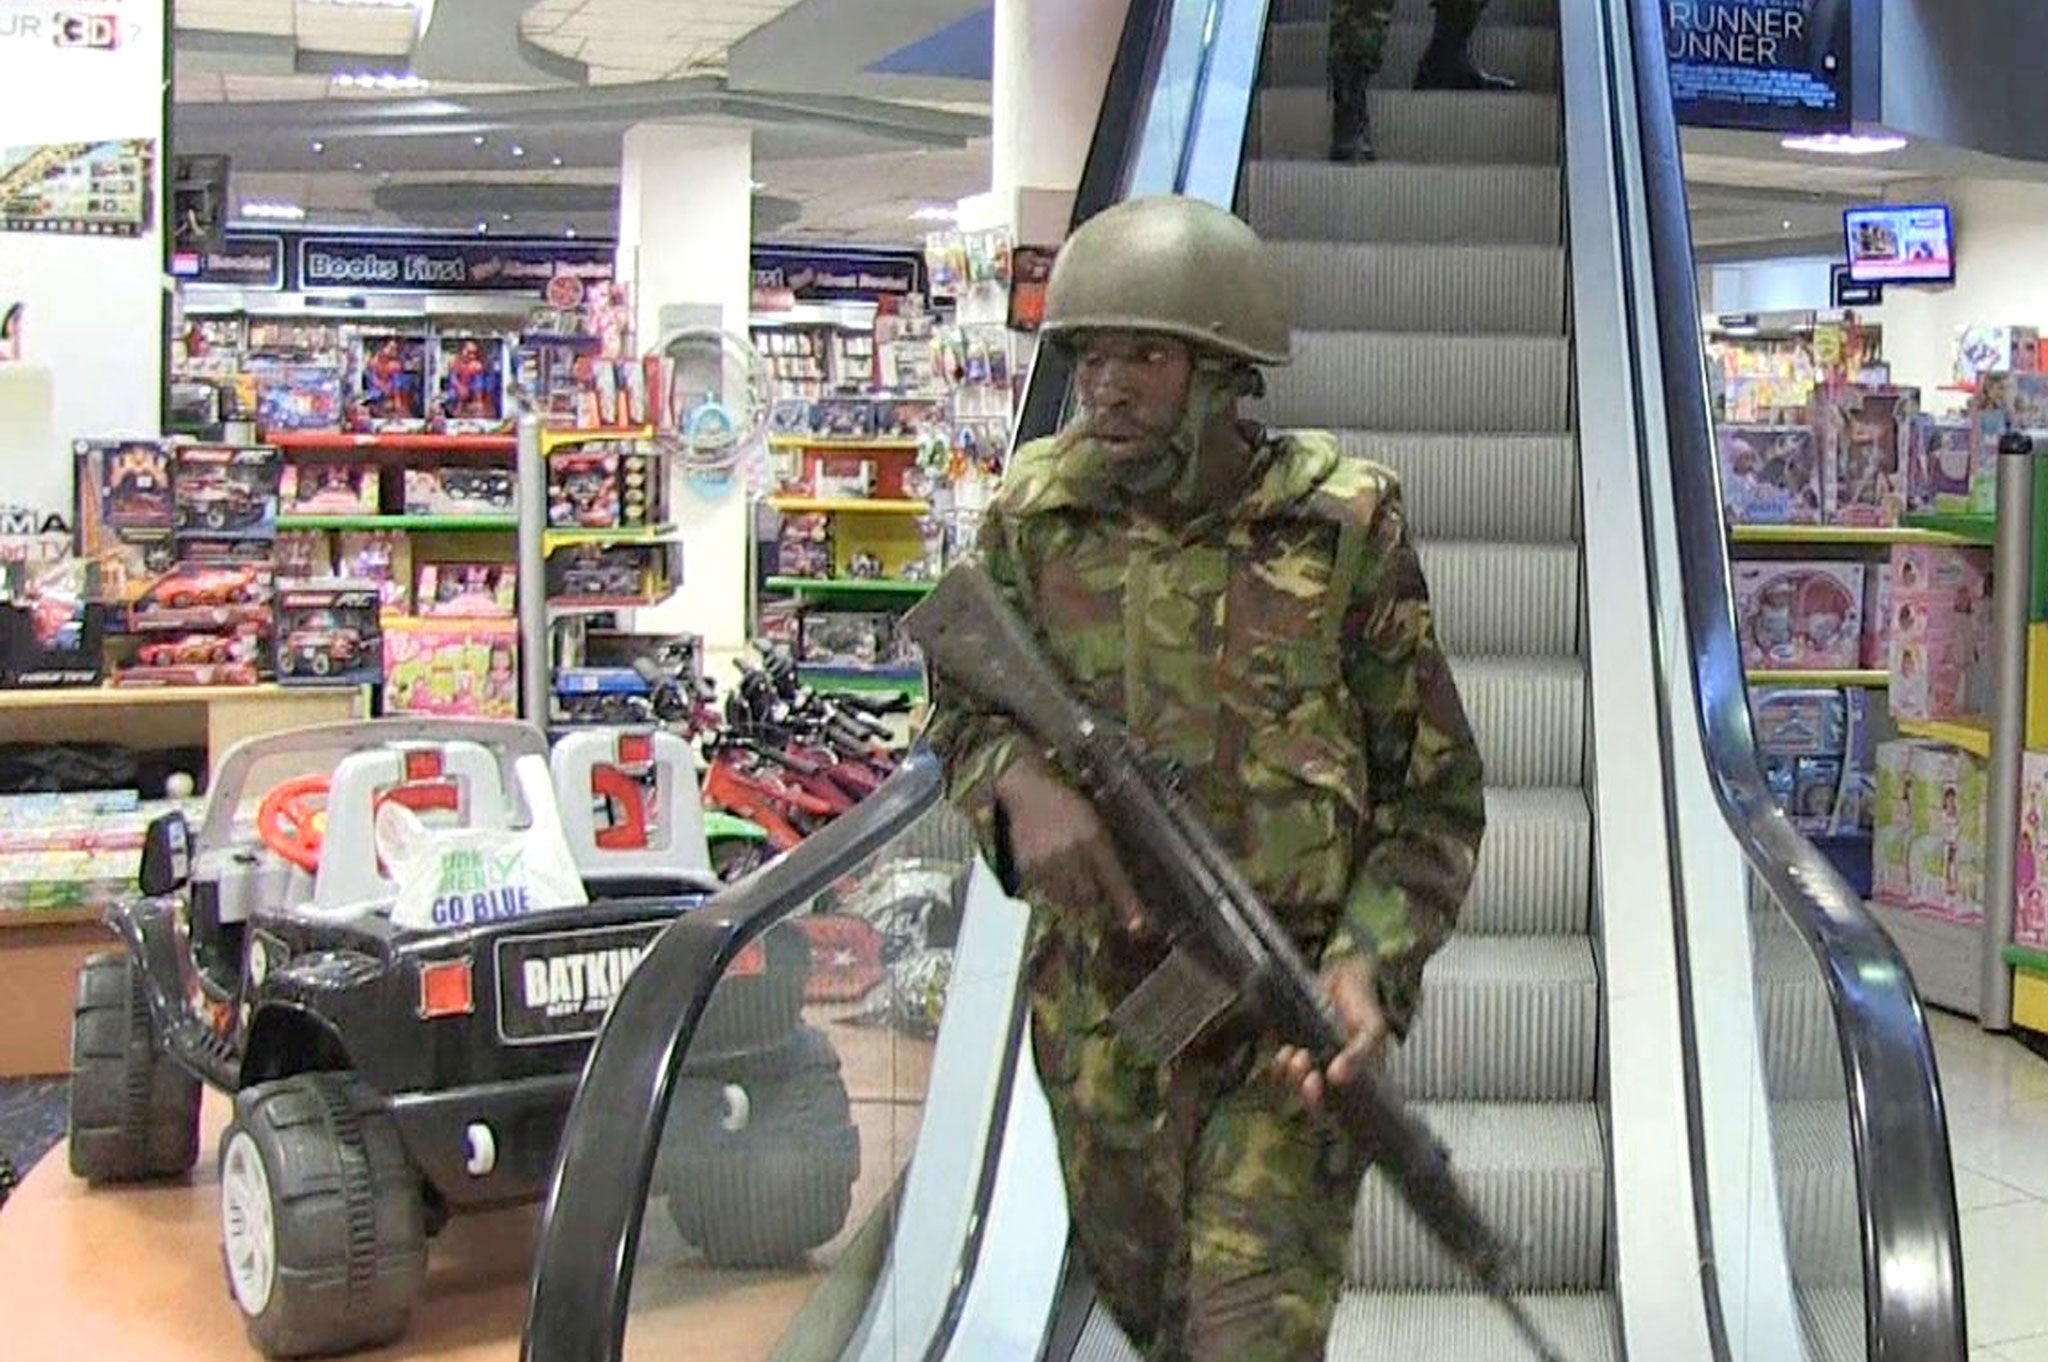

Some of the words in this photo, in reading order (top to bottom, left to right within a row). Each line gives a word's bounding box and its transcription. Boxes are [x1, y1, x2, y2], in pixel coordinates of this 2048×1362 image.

[53, 12, 116, 50] 3D
[1669, 2, 1803, 39] RUNNER
[308, 253, 399, 280] Books
[403, 254, 466, 281] First
[432, 895, 463, 925] GO
[472, 886, 528, 924] BLUE
